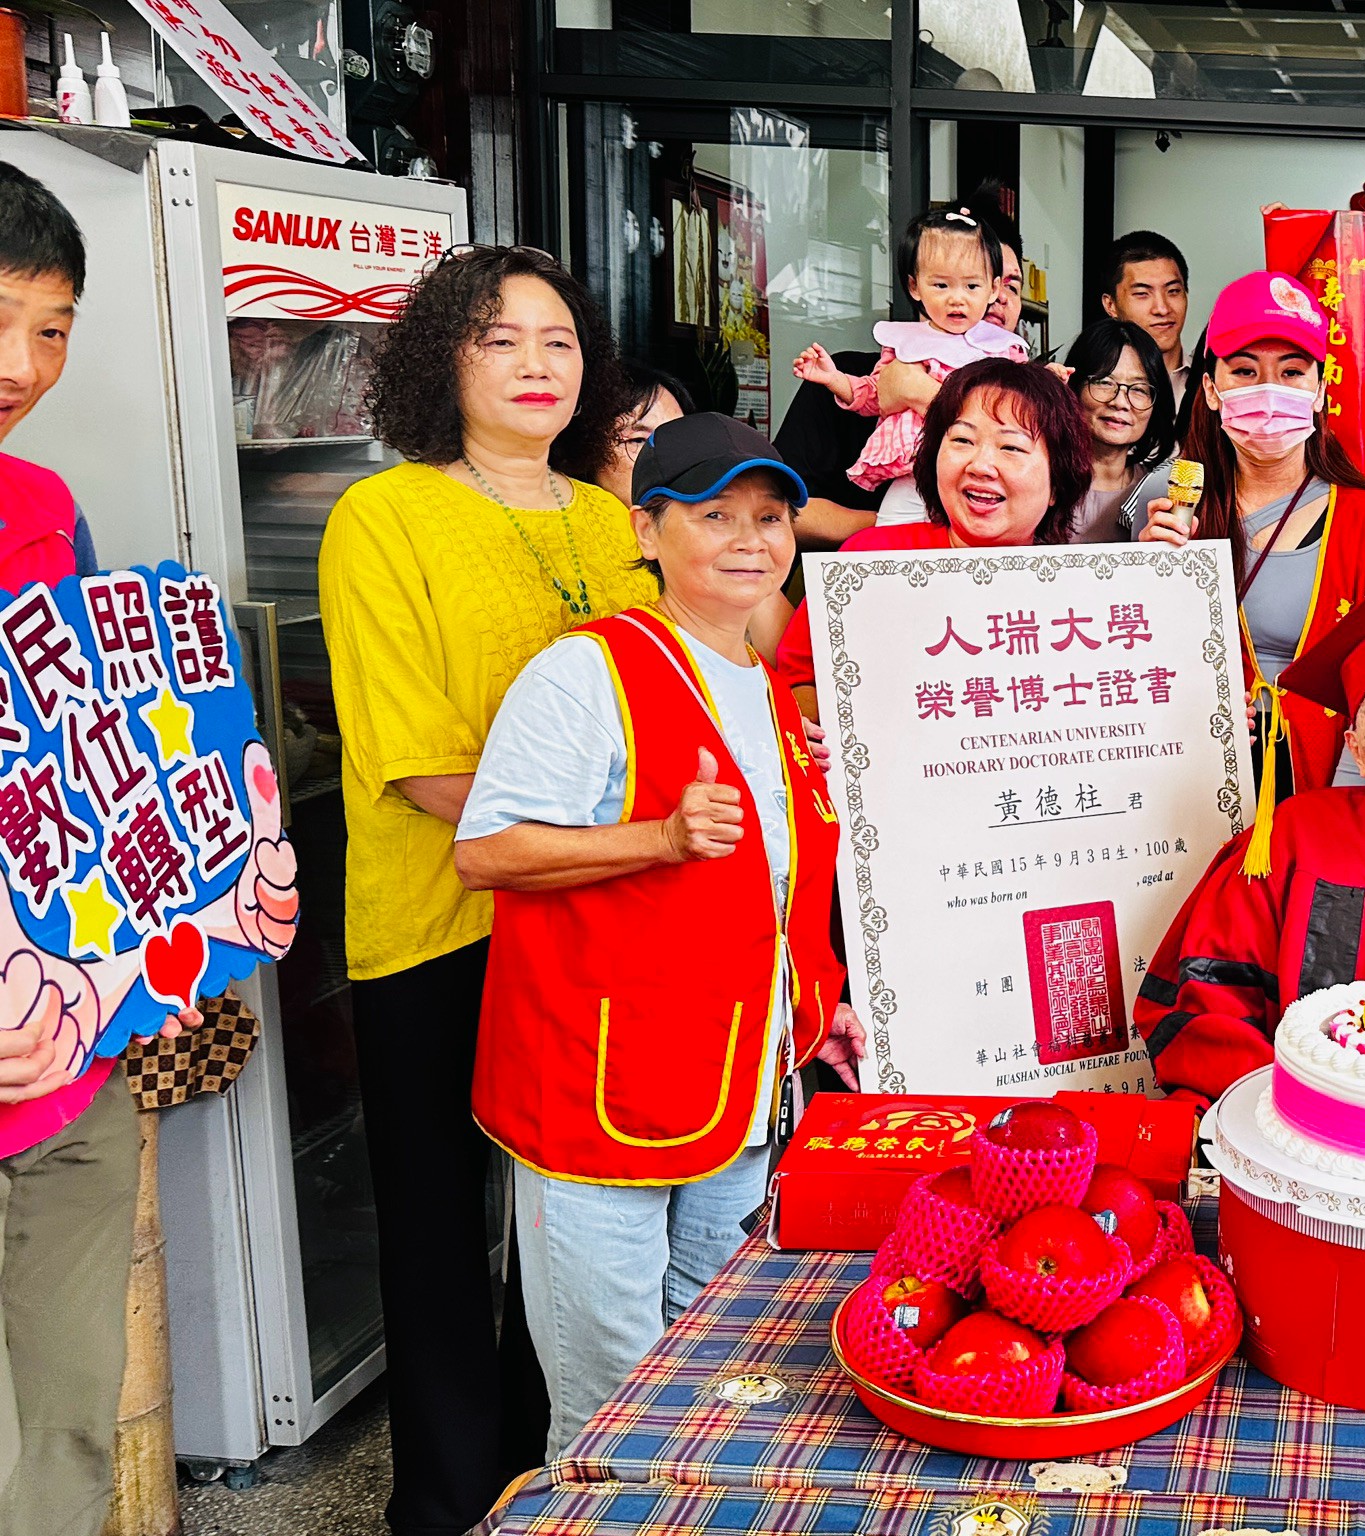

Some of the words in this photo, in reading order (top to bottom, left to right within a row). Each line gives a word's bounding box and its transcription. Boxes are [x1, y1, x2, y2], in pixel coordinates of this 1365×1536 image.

[233, 207, 342, 250] SANLUX
[350, 221, 442, 259] 台灣三洋
[925, 603, 1152, 656] 人瑞大學
[915, 666, 1176, 720] 榮譽博士證書
[960, 727, 1062, 751] CENTENARIAN
[1066, 722, 1147, 742] UNIVERSITY
[923, 758, 1005, 778] HONORARY
[1009, 750, 1095, 770] DOCTORATE
[1098, 742, 1184, 762] CERTIFICATE
[994, 783, 1102, 822] 黃德柱
[1128, 792, 1143, 810] 君
[1142, 871, 1163, 885] aged
[1164, 871, 1174, 881] at
[946, 896, 967, 909] who
[969, 895, 988, 905] was
[990, 892, 1013, 904] born
[1016, 891, 1028, 900] on
[996, 1068, 1040, 1088] HUASHAN
[1043, 1062, 1077, 1079] SOCIAL
[1079, 1055, 1120, 1071] WELFARE
[1124, 1049, 1152, 1065] FOUN
